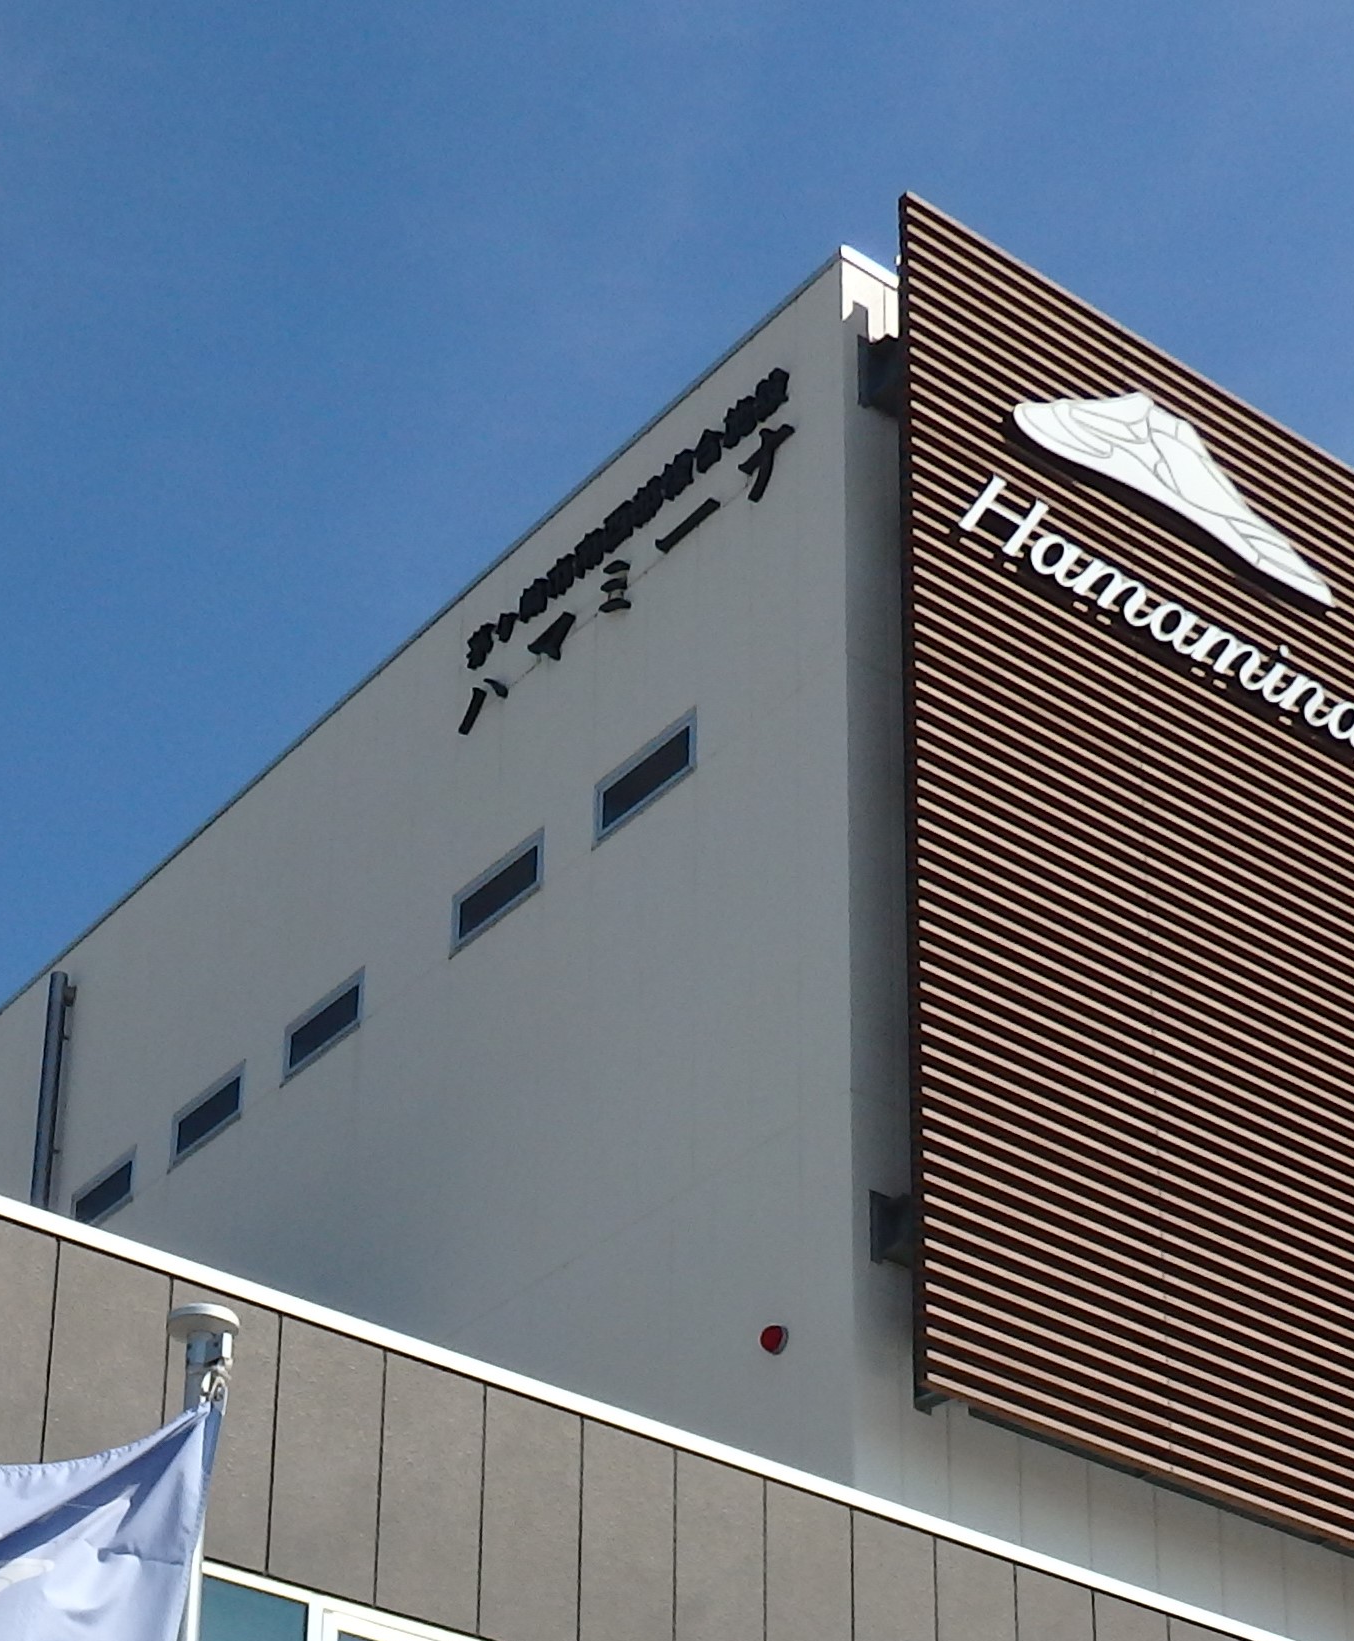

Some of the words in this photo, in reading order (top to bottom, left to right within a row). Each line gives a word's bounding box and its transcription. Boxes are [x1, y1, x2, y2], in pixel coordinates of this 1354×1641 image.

[458, 423, 795, 735] ハマミーナ
